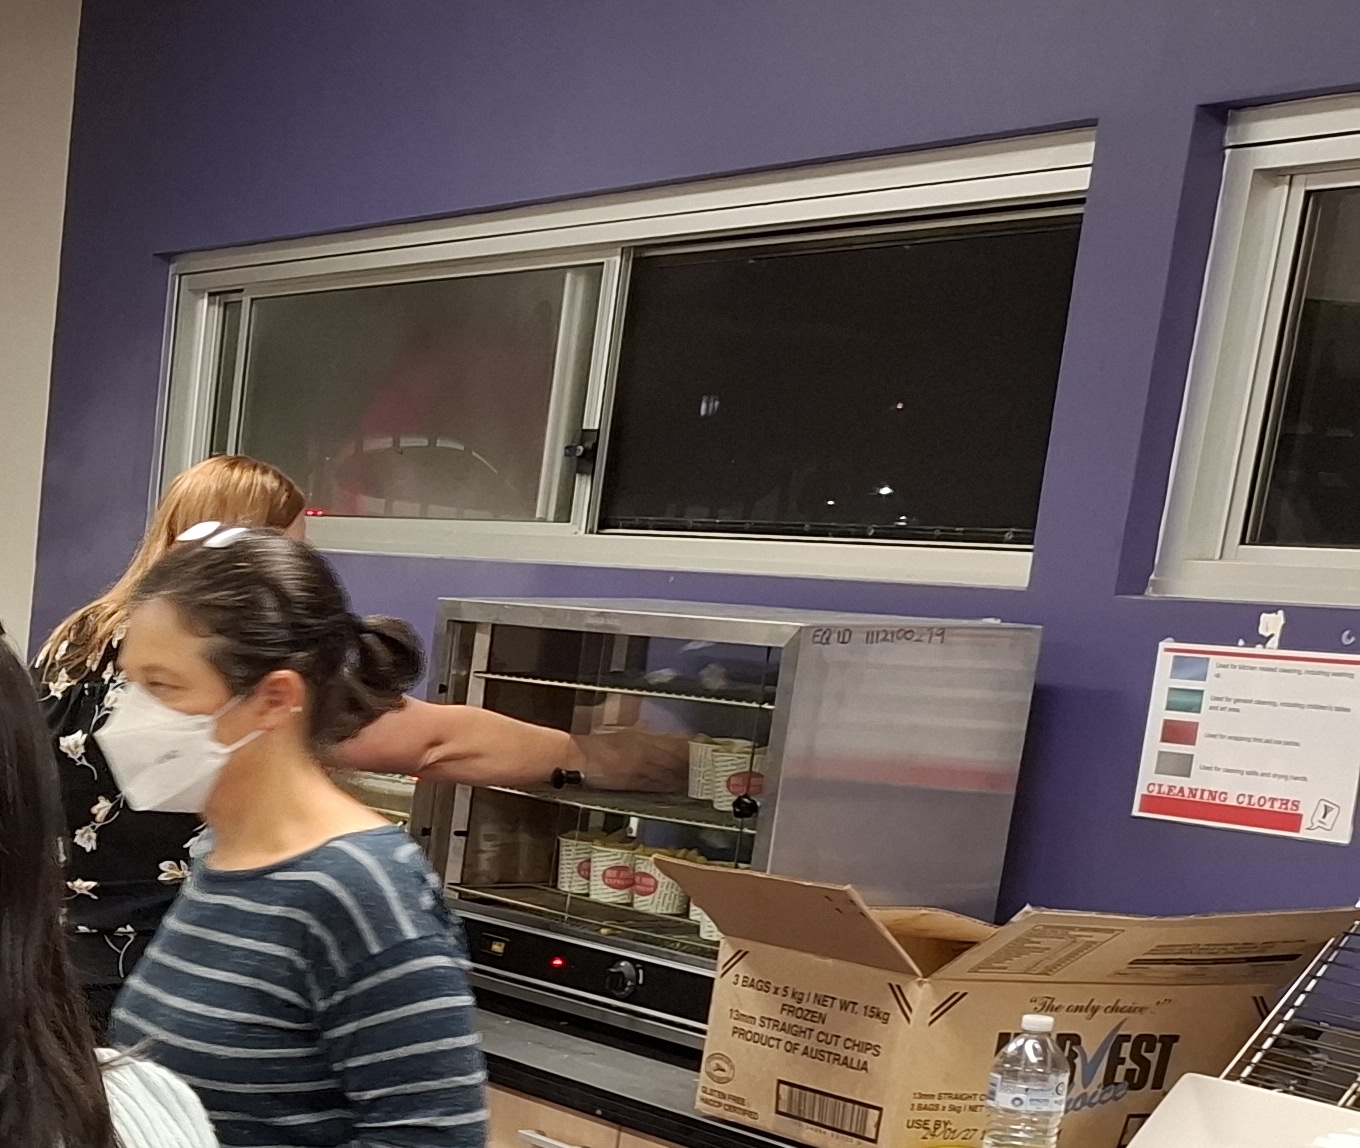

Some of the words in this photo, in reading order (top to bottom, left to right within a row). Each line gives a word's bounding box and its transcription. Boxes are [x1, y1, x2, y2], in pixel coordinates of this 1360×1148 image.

[811, 628, 831, 645] EQ
[836, 628, 853, 645] ID
[1146, 782, 1229, 804] CLEANING
[1236, 793, 1301, 812] CLOTHS
[733, 974, 740, 986] 3
[741, 976, 772, 994] BAGS
[773, 985, 780, 995] x
[781, 986, 790, 998] 5
[790, 988, 806, 1005] kg
[813, 992, 839, 1010] NET
[862, 1004, 891, 1024] 15kg
[1065, 998, 1102, 1018] only
[779, 1003, 828, 1025] FROZEN
[729, 1008, 756, 1026] 13mm
[758, 1015, 815, 1042] STRAIGHT
[816, 1030, 842, 1047] CUT
[843, 1036, 882, 1058] CHIPS
[731, 1026, 783, 1050] PRODUCT
[784, 1040, 800, 1054] OF
[801, 1045, 869, 1074] AUSTRALIA
[917, 1102, 940, 1111] BAGS
[968, 1104, 985, 1112] NET
[937, 1092, 979, 1101] STRAIGHT
[906, 1118, 931, 1131] USE
